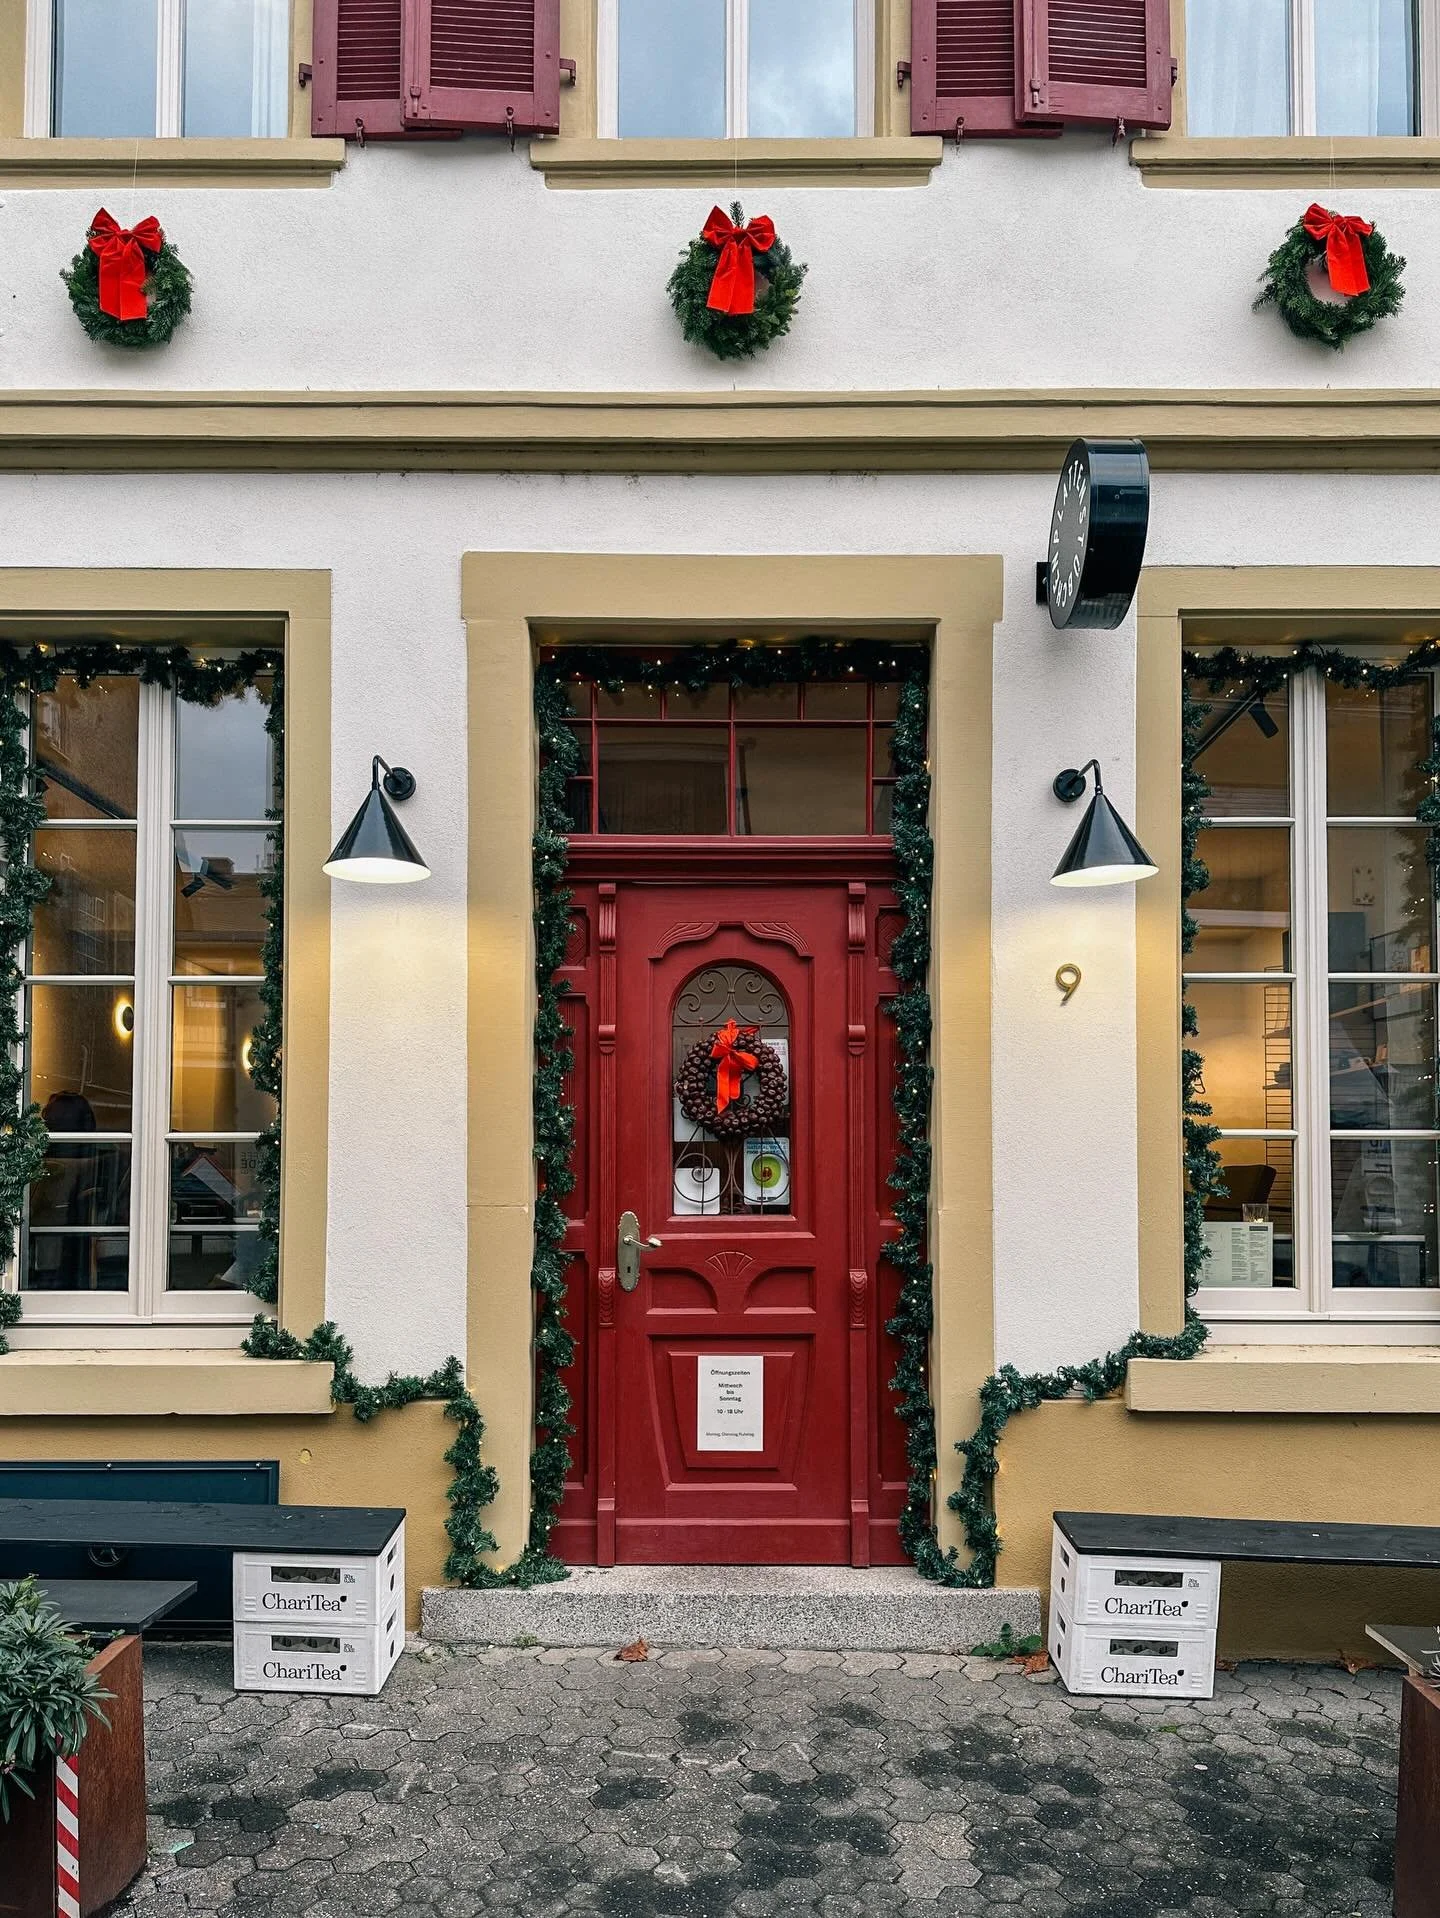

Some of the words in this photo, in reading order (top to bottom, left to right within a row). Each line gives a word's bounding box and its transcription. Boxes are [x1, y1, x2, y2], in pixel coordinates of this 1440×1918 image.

[1055, 963, 1082, 1002] 9
[262, 1592, 342, 1611] ChariTea
[1104, 1597, 1183, 1617] ChariTea
[262, 1662, 342, 1681] ChariTea
[1100, 1666, 1179, 1685] ChariTea
